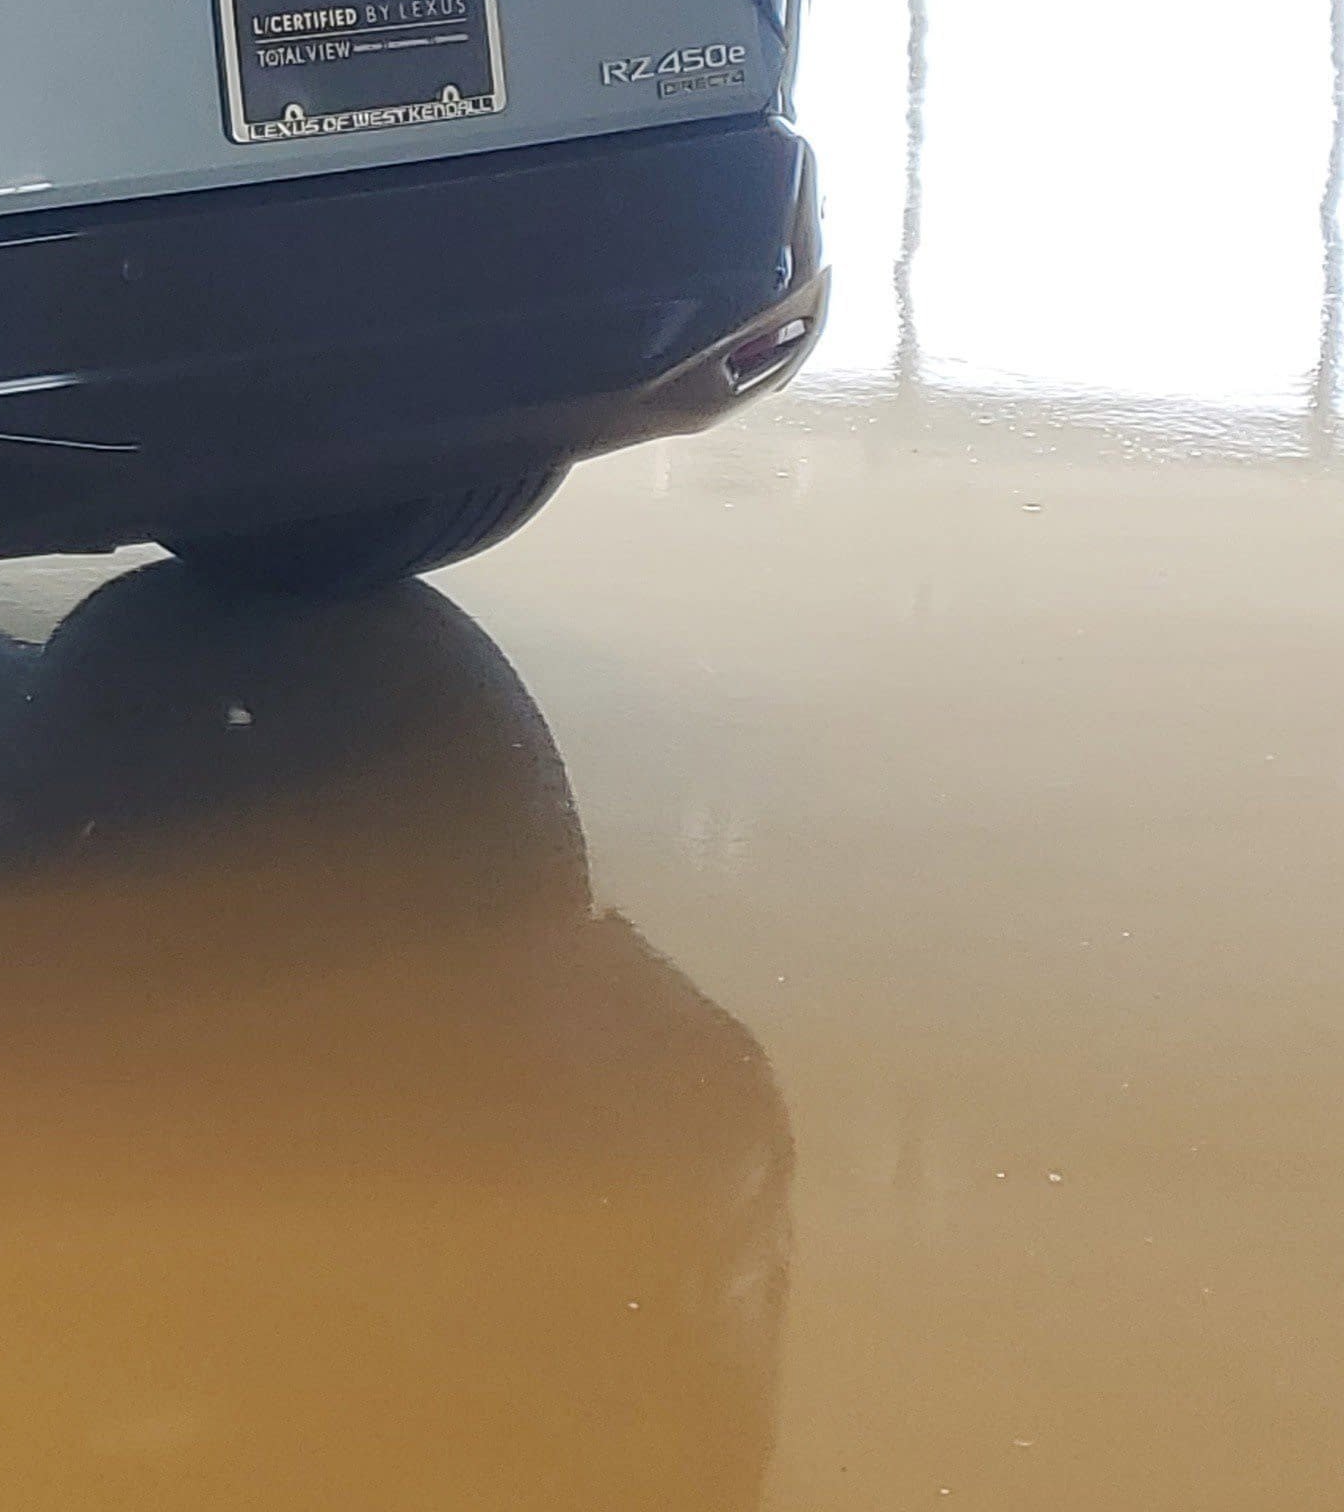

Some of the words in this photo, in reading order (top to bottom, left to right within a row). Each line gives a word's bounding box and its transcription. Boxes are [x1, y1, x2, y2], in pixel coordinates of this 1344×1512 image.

[253, 8, 357, 35] L/CERTIFIED
[366, 4, 389, 23] BY
[256, 47, 306, 67] TOTAL
[306, 40, 350, 62] VIEW
[250, 117, 320, 141] LEXUS
[323, 115, 350, 134] OF
[352, 106, 406, 129] WEST
[407, 96, 493, 125] KENDALL
